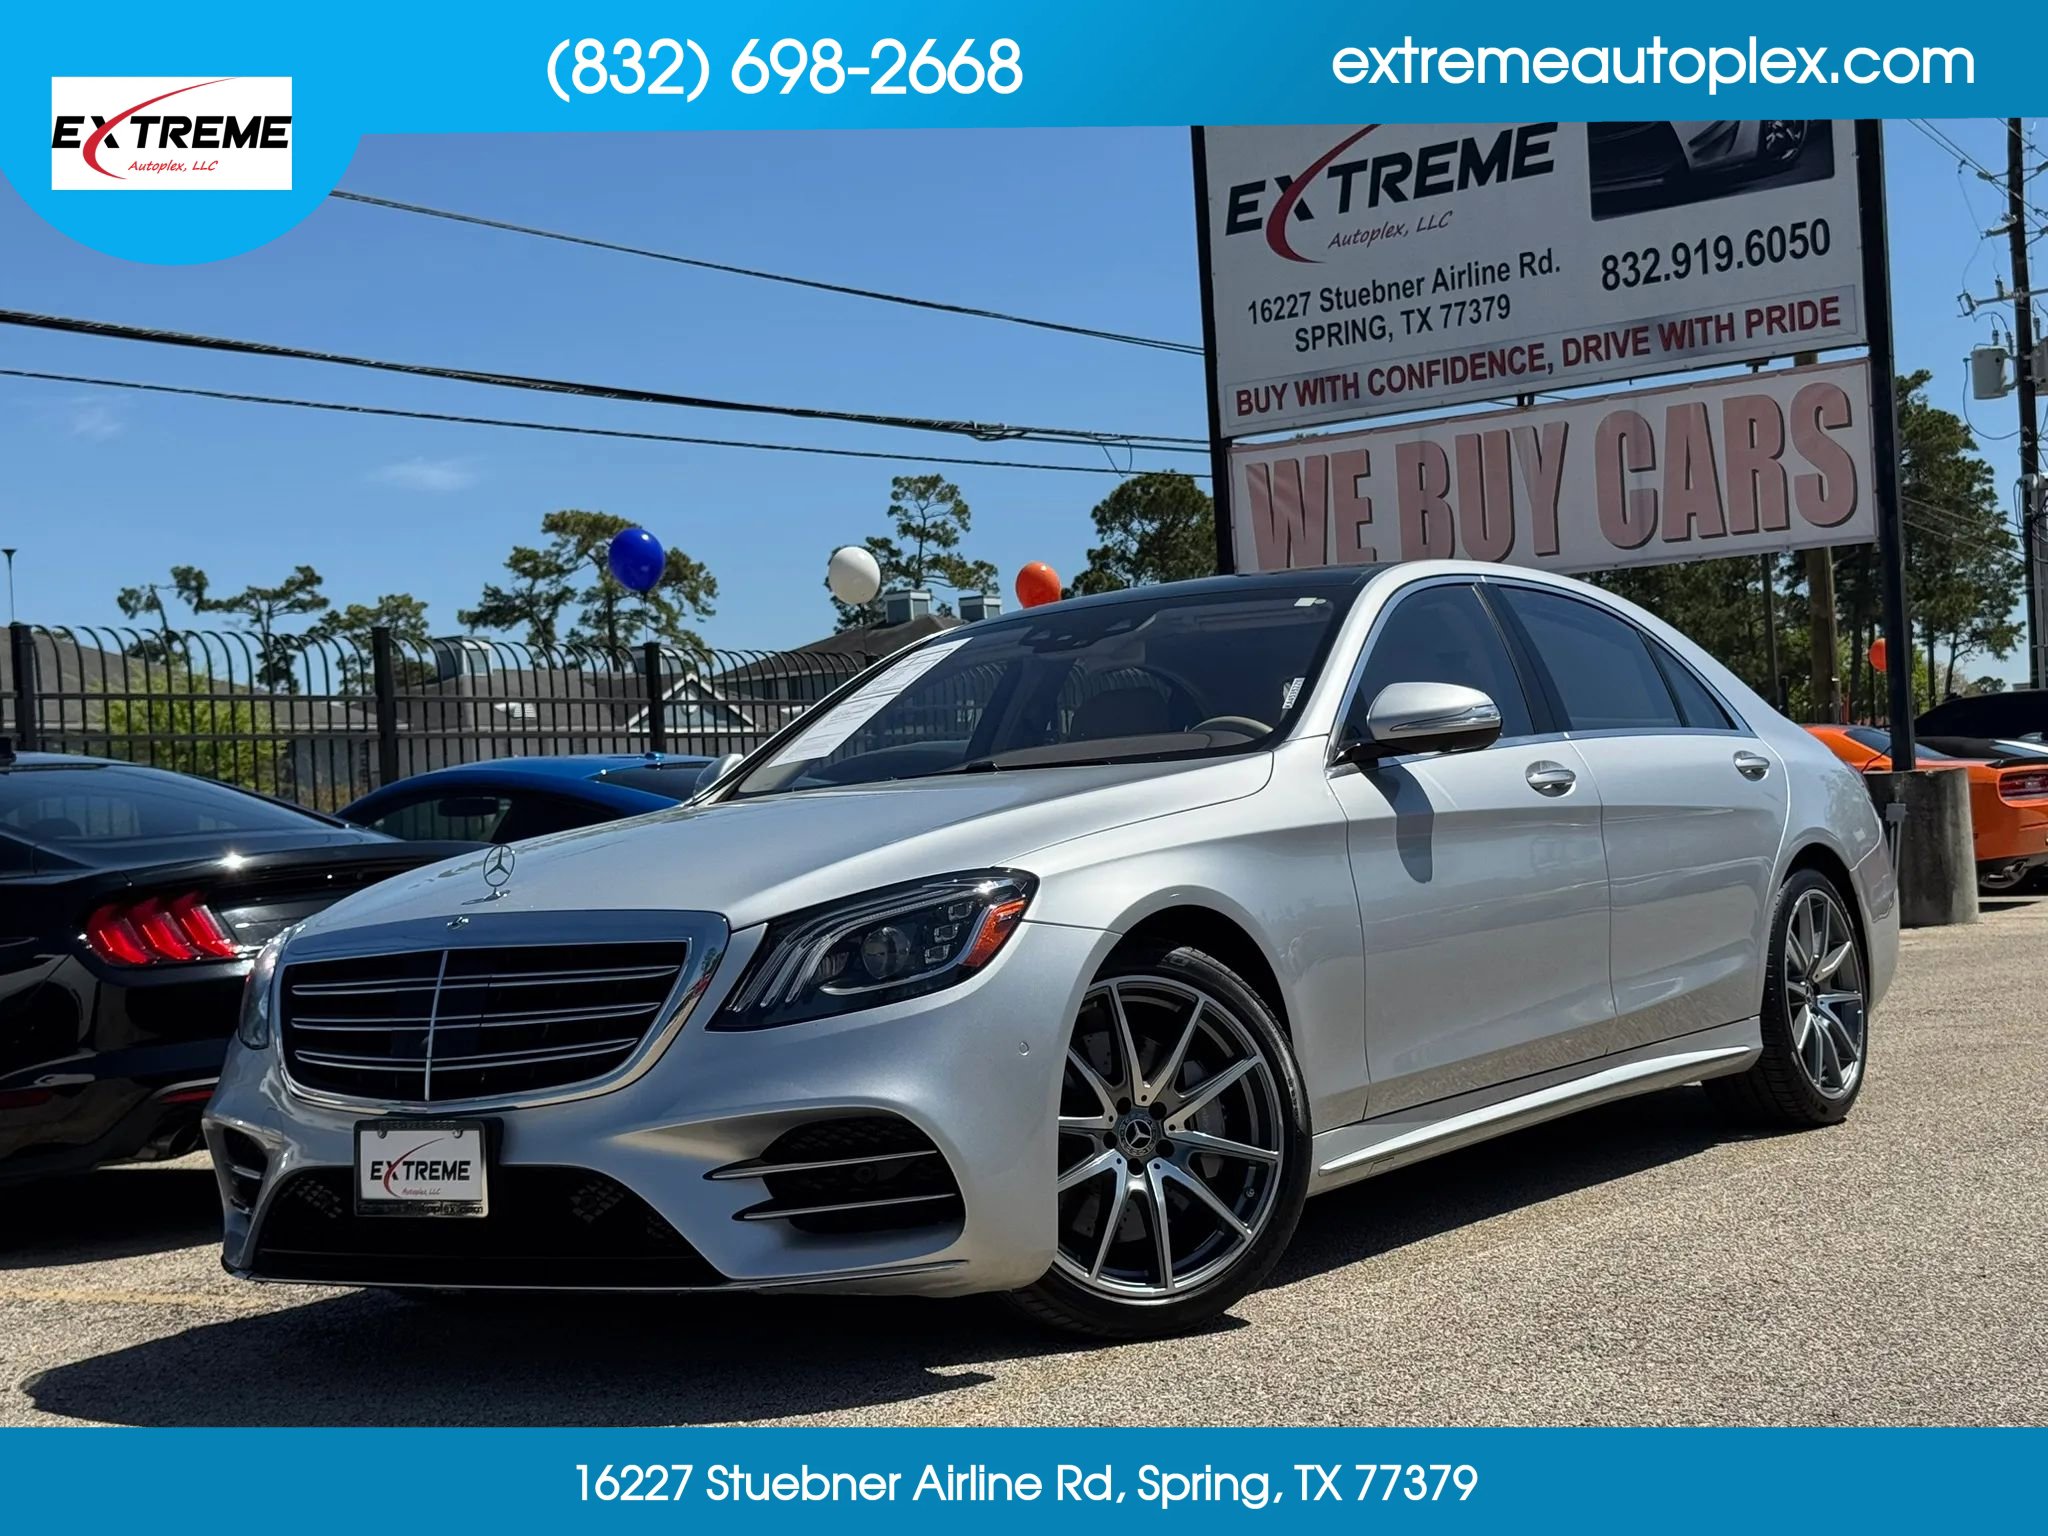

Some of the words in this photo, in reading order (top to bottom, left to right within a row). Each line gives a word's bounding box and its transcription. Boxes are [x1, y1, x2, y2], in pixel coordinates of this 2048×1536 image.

[1225, 121, 1558, 236] EXTREME
[1327, 220, 1409, 249] Autoplex,
[1416, 210, 1454, 233] LLC
[1601, 218, 1831, 291] 832.919.6050
[1248, 291, 1311, 325] 16227
[1319, 277, 1425, 313] Stuebner
[1432, 260, 1511, 294] Airline
[1519, 248, 1561, 278] Rd.
[1295, 315, 1394, 352] SPRING,
[1400, 306, 1433, 335] TX
[1440, 294, 1511, 329] 77379
[1235, 382, 1288, 416] BUY
[1294, 372, 1360, 407] WITH
[1367, 343, 1554, 397] CONFIDENCE,
[1562, 326, 1651, 367] DRIVE
[1657, 312, 1735, 352] WITH
[1745, 296, 1841, 339] PRIDE
[1245, 448, 1378, 570] WE
[1395, 421, 1570, 563] BUY
[1594, 382, 1858, 550] CARS
[370, 1160, 471, 1181] EXTREME
